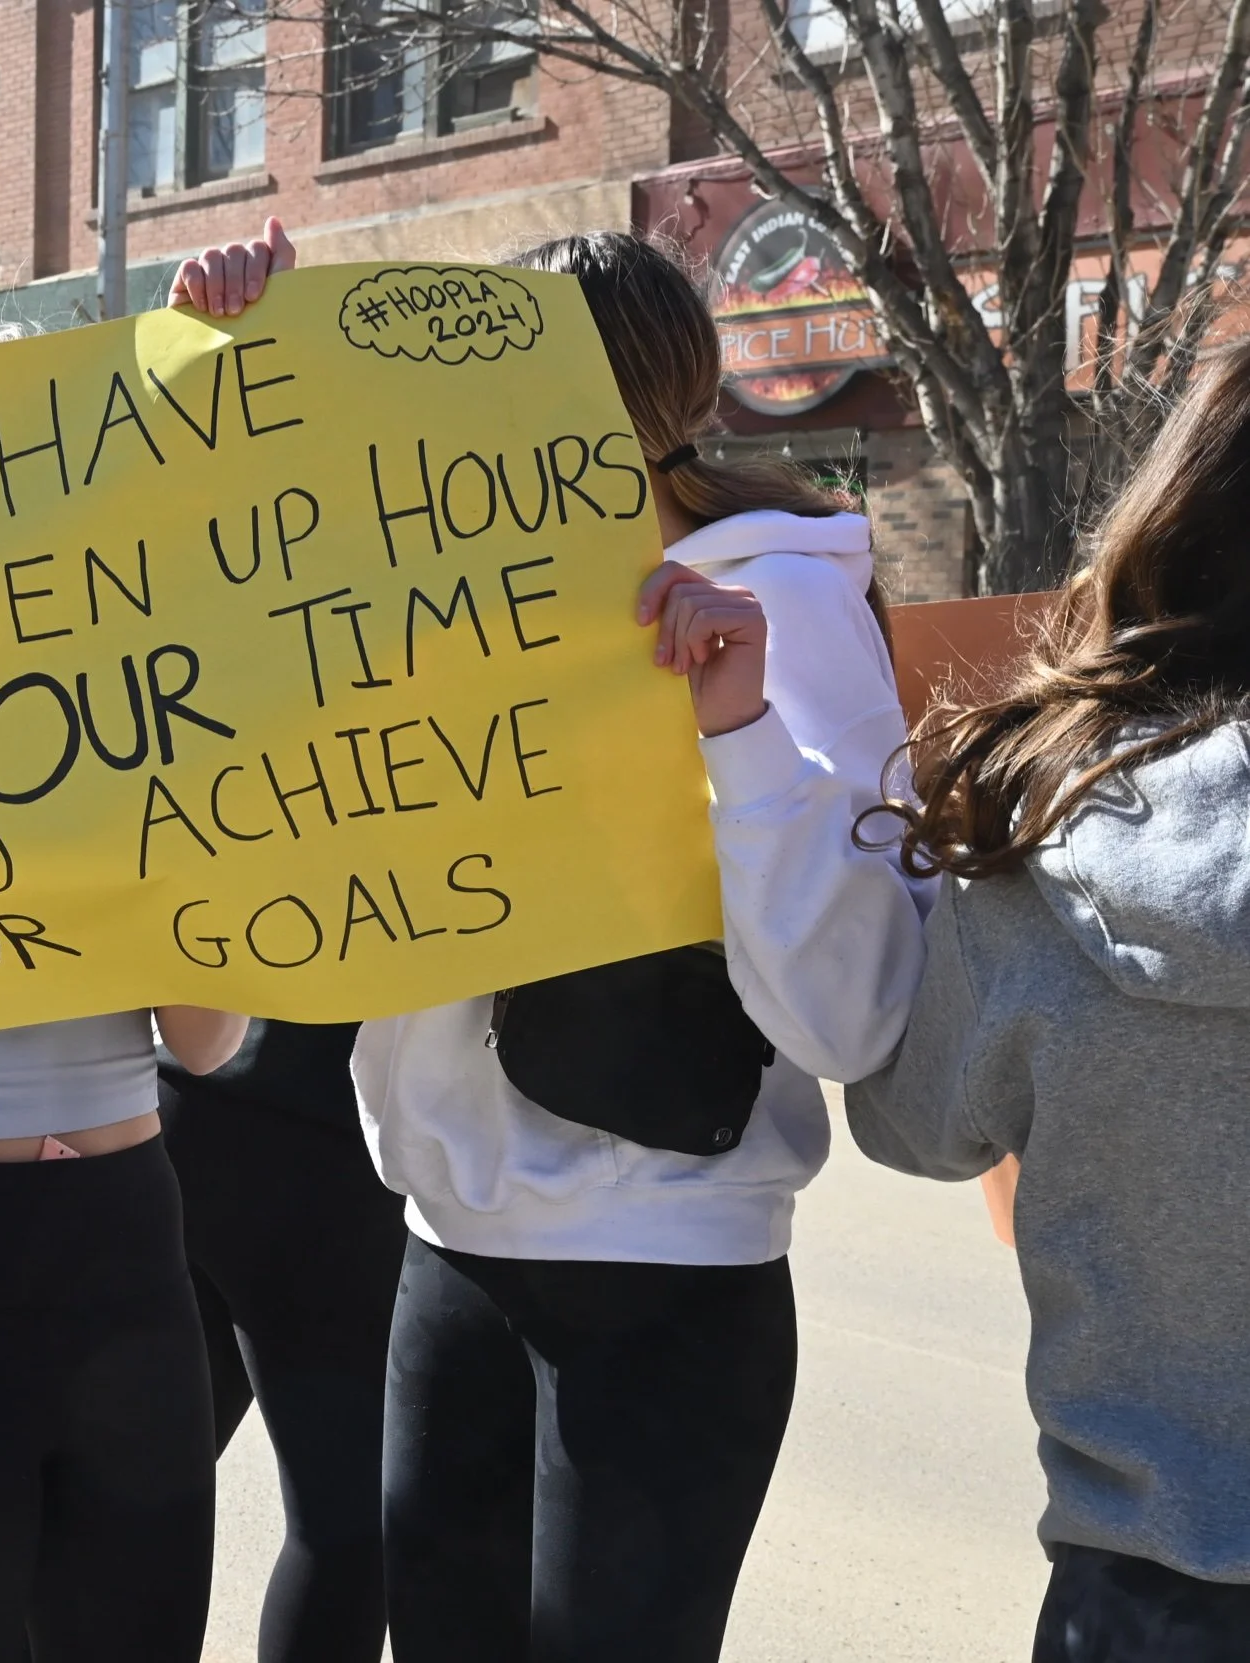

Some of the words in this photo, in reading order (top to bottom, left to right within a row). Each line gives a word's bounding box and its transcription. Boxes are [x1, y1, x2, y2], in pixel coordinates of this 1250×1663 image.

[725, 240, 751, 284] EAST
[751, 211, 805, 243] INDIAN
[355, 280, 498, 332] #HOOPLA
[427, 302, 526, 342] 2024
[721, 328, 796, 364] PICE
[209, 487, 320, 585] UP
[369, 432, 648, 568] HOURS
[268, 556, 561, 708] TIME
[139, 698, 563, 880] ACHIEVE
[172, 853, 512, 968] GOALS
